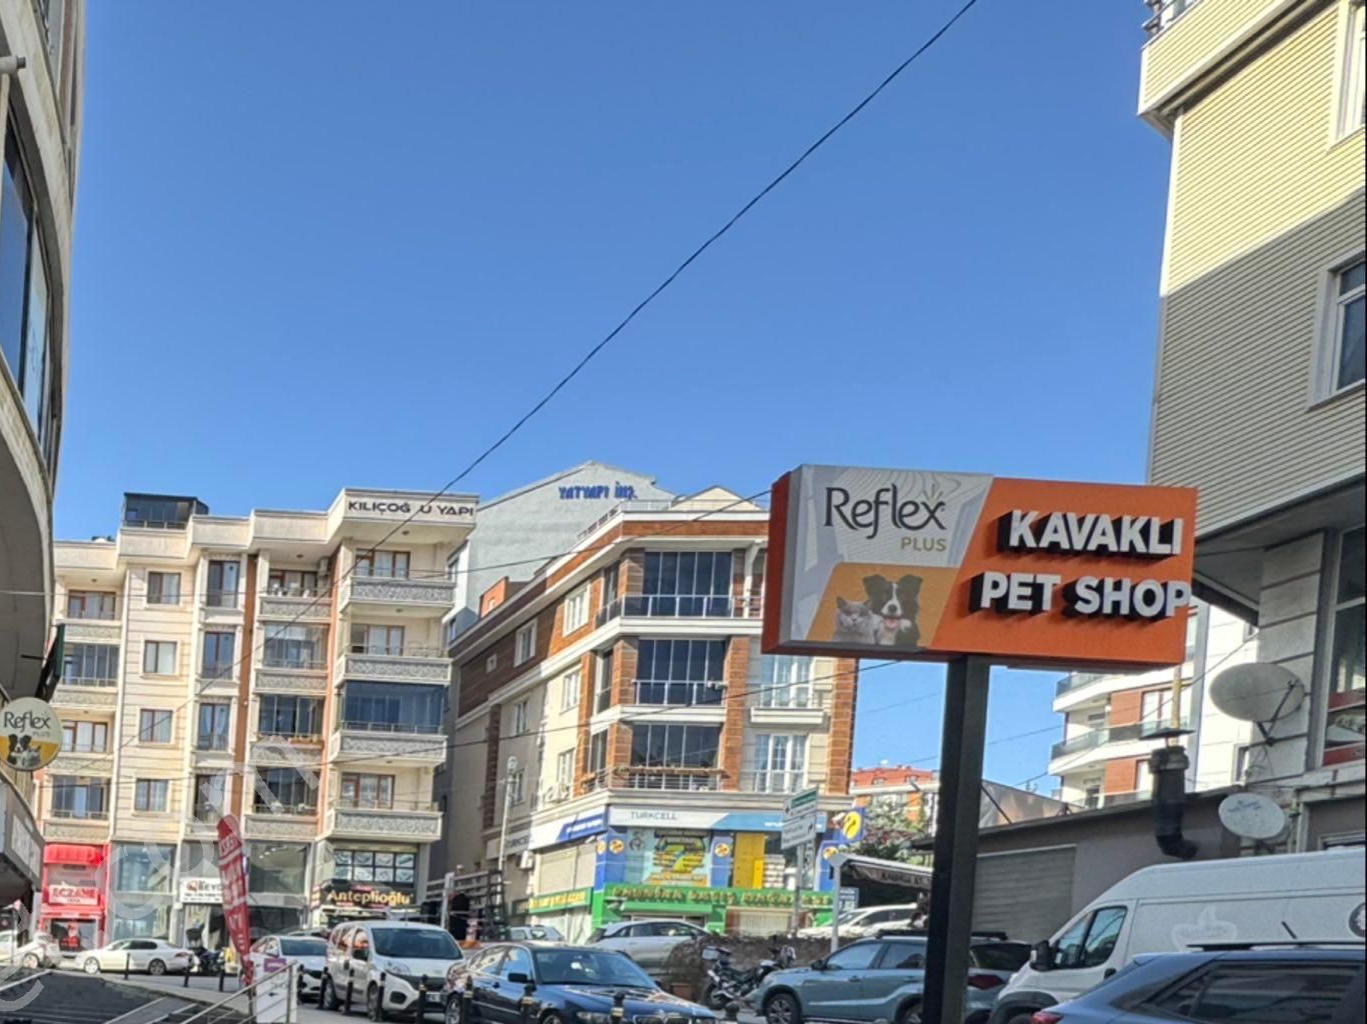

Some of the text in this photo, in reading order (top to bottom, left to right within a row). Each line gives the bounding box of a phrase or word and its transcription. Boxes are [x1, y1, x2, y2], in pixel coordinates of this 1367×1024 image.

[348, 500, 474, 517] KILIÇOĞU YAPI
[824, 483, 947, 540] Reflex
[1008, 509, 1184, 556] KAVAKLI
[900, 536, 947, 553] PLUS
[980, 572, 1193, 618] PET SHOP
[3, 710, 51, 733] Reflex
[630, 811, 678, 821] TURKCELL
[53, 888, 96, 899] ECZANE
[326, 889, 411, 907] Anteplioğlu
